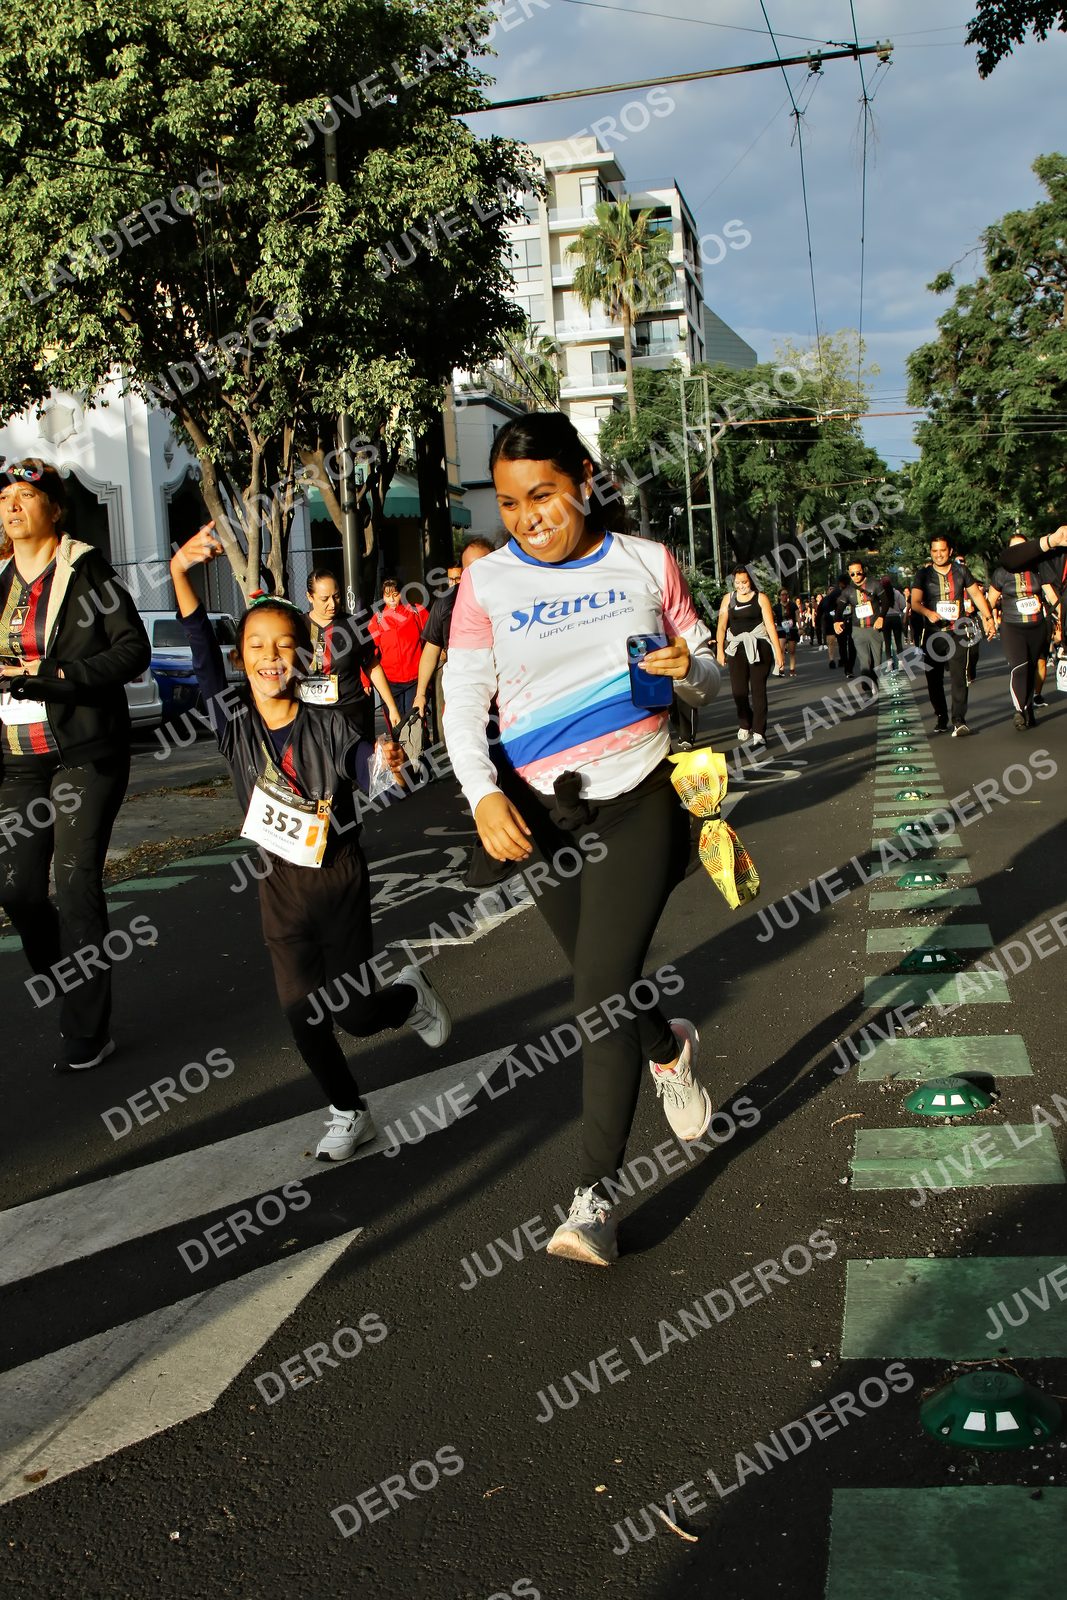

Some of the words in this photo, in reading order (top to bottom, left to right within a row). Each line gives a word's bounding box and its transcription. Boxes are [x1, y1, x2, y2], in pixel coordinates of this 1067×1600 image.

[539, 622, 575, 639] WAVE
[577, 606, 635, 627] RUNNERS
[262, 804, 303, 840] 352
